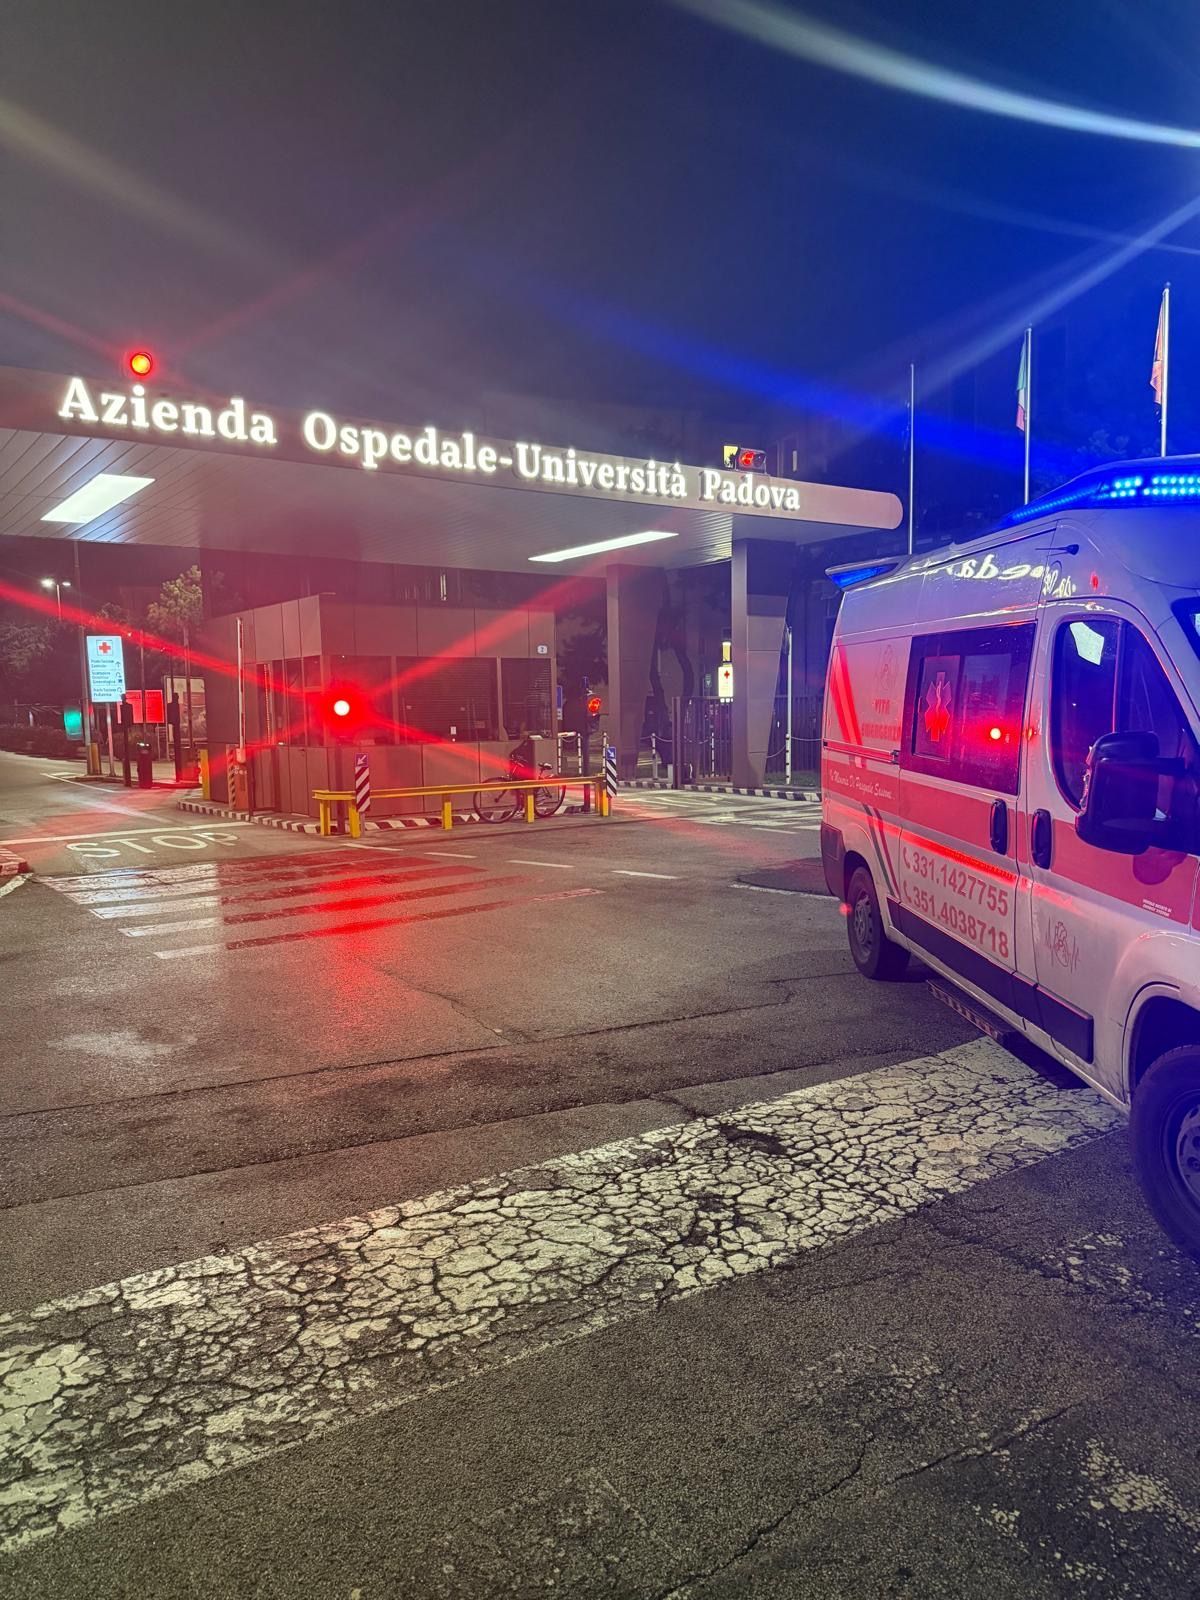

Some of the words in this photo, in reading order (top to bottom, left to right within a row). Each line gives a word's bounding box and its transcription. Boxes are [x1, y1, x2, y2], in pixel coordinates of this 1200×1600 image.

[58, 376, 277, 446] Azienda
[702, 468, 800, 511] Padova
[912, 851, 1009, 917] 331.1427755
[912, 886, 1010, 959] 351.4038718
